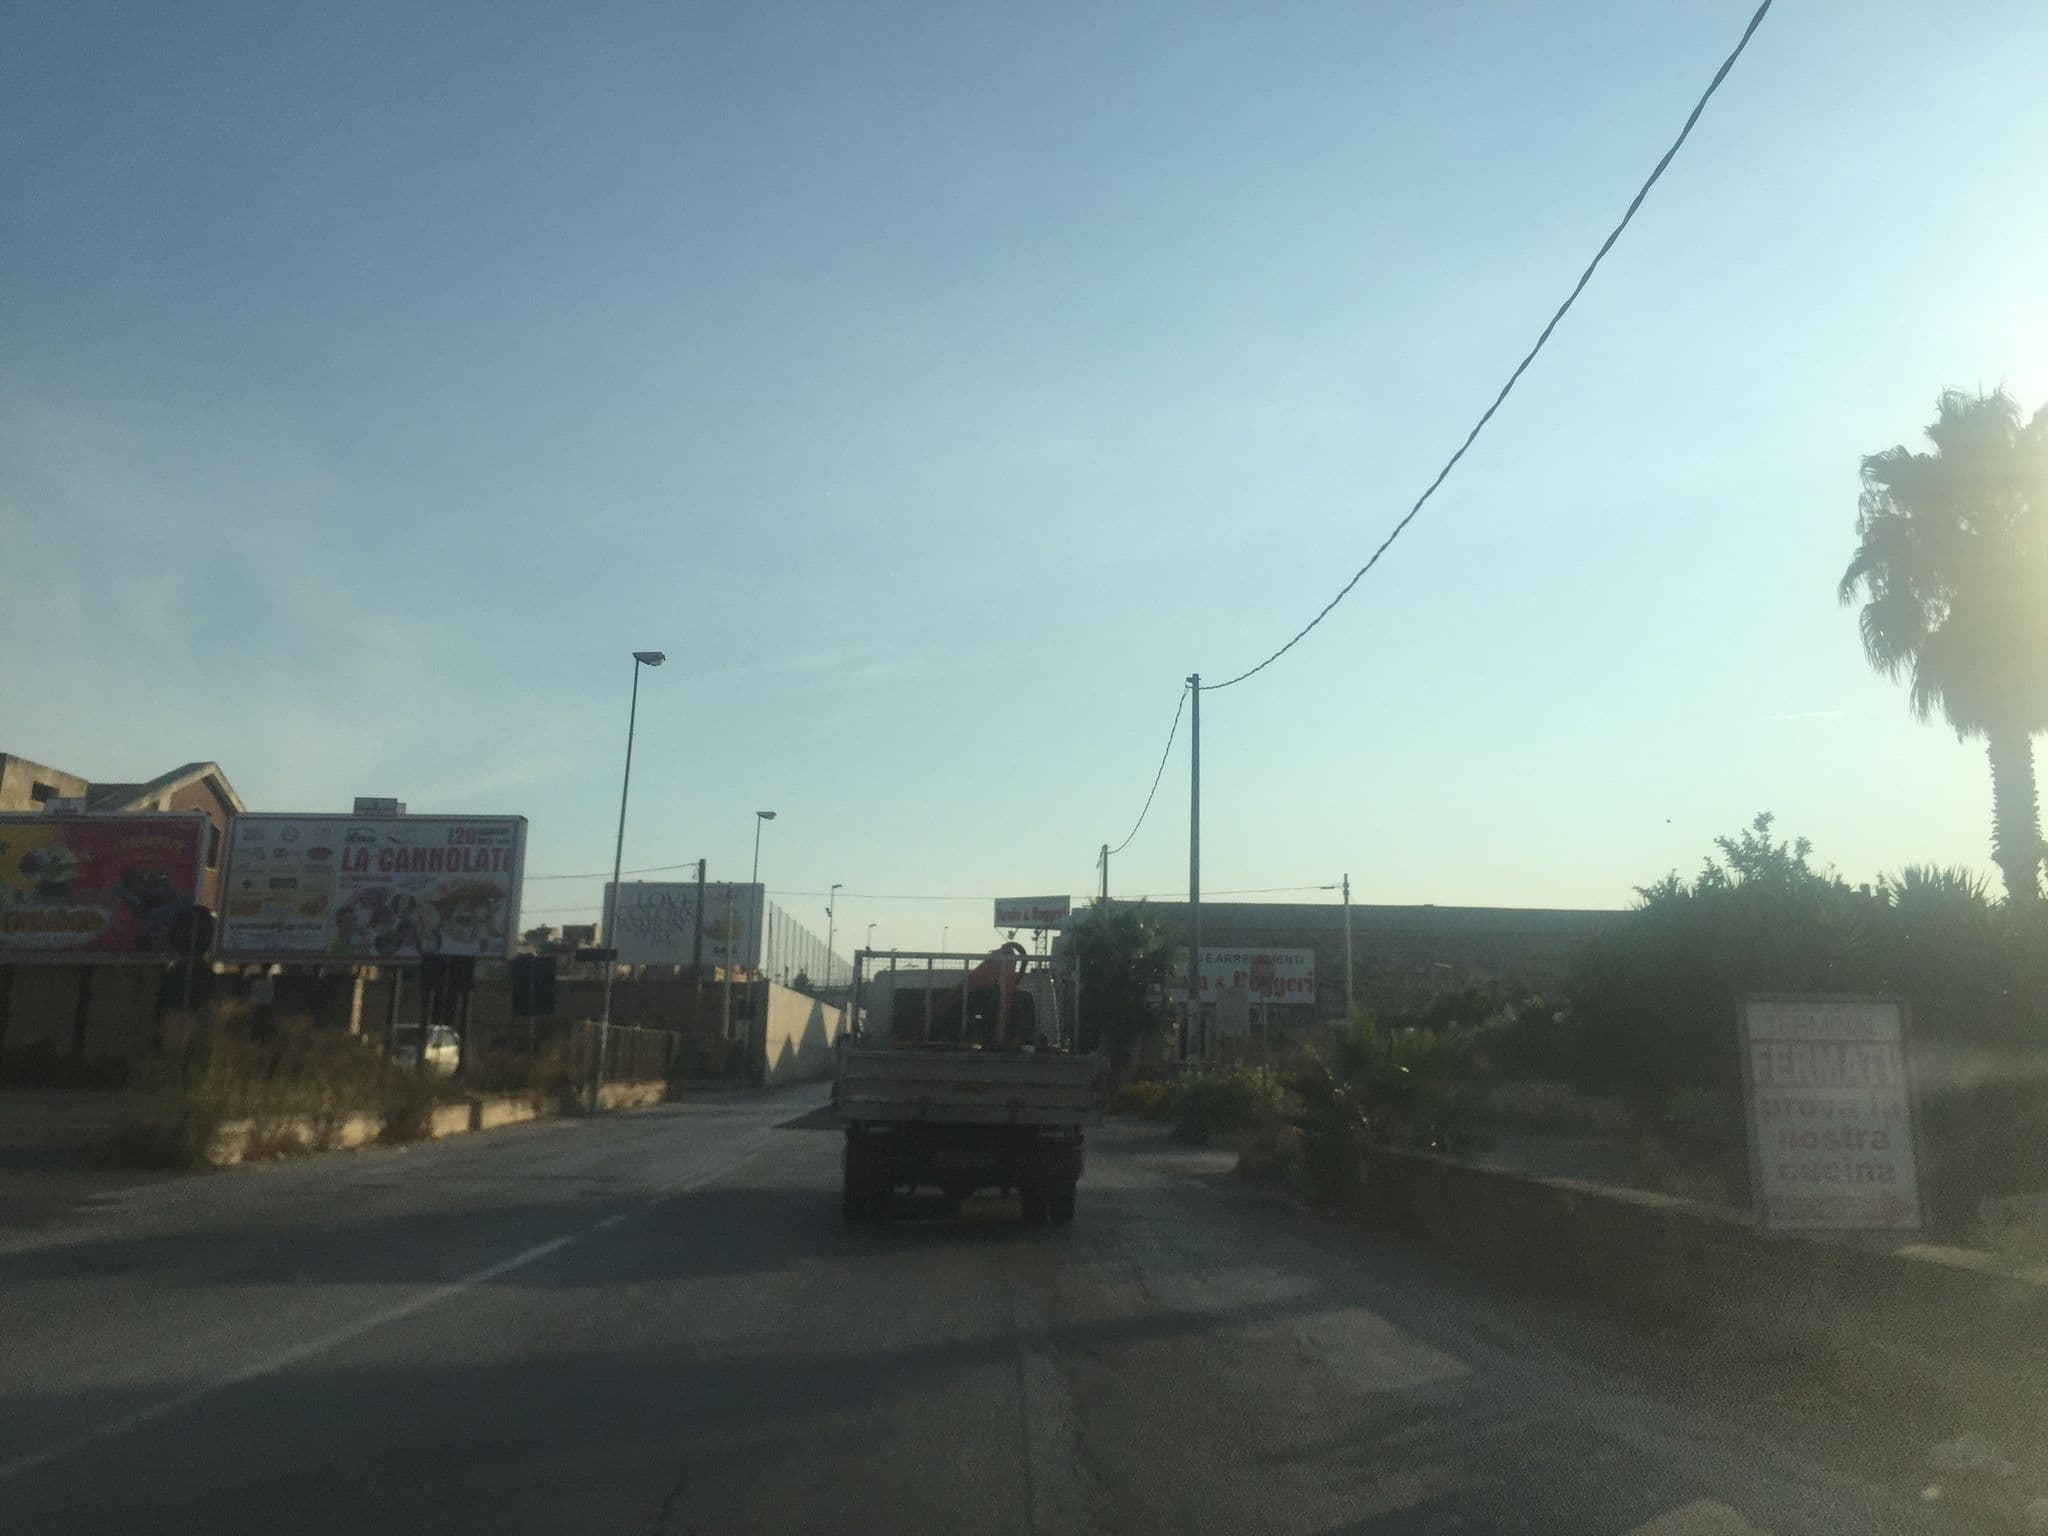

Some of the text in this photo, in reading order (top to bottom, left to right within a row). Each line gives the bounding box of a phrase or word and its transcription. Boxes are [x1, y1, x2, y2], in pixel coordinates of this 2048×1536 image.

[341, 847, 369, 873] LA
[1216, 953, 1305, 965] ARREENTI
[1779, 1124, 1890, 1151] nostra
